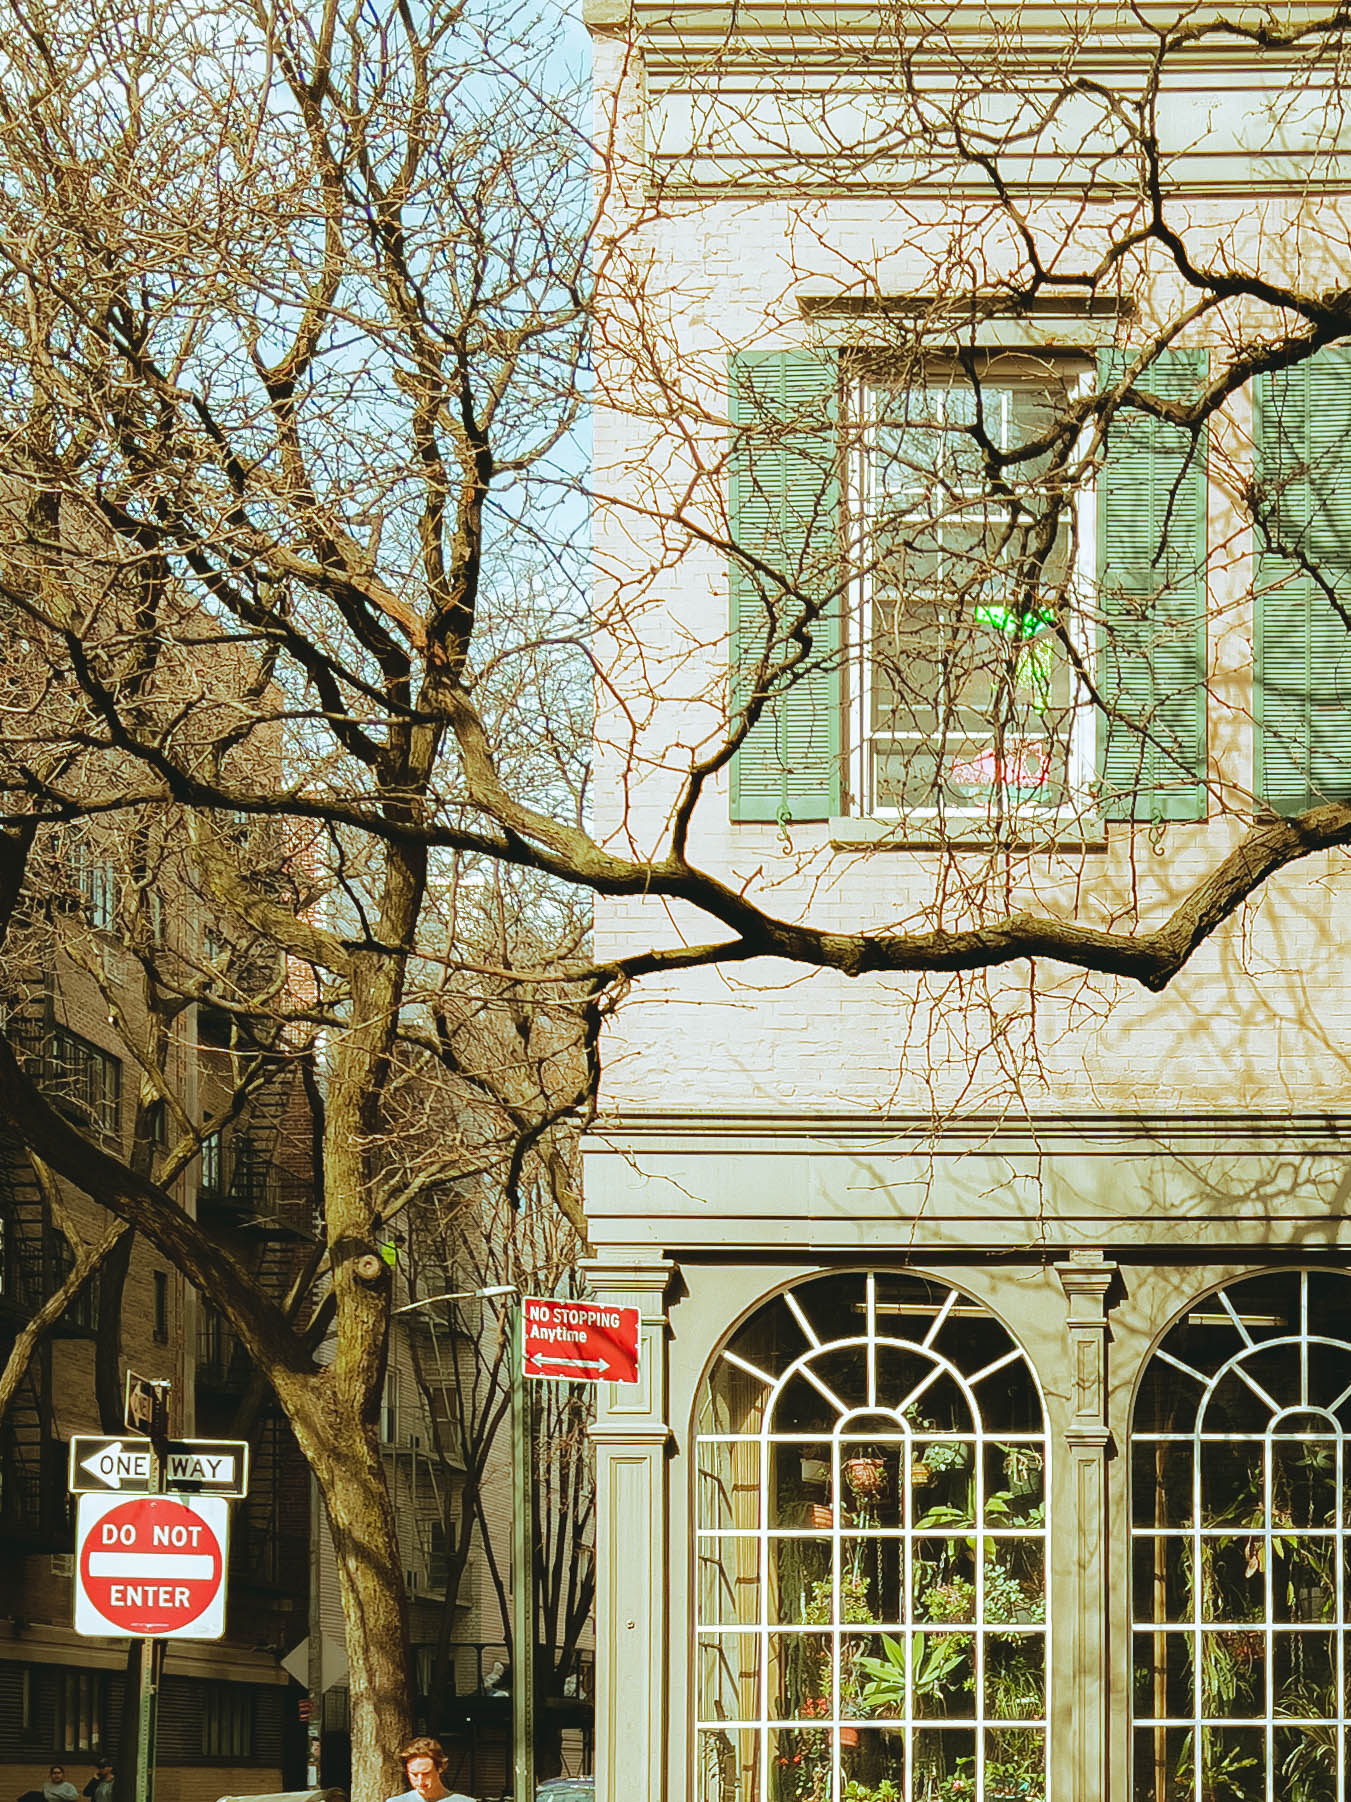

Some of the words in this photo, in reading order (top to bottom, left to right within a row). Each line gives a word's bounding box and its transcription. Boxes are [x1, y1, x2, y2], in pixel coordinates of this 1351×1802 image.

[529, 1306, 550, 1322] NO
[553, 1308, 620, 1328] STOPPING
[530, 1324, 587, 1343] Anytime
[100, 1455, 147, 1476] ONE
[171, 1457, 222, 1479] WAY
[101, 1523, 137, 1546] DO
[153, 1525, 202, 1548] NOT
[109, 1584, 190, 1608] ENTER
